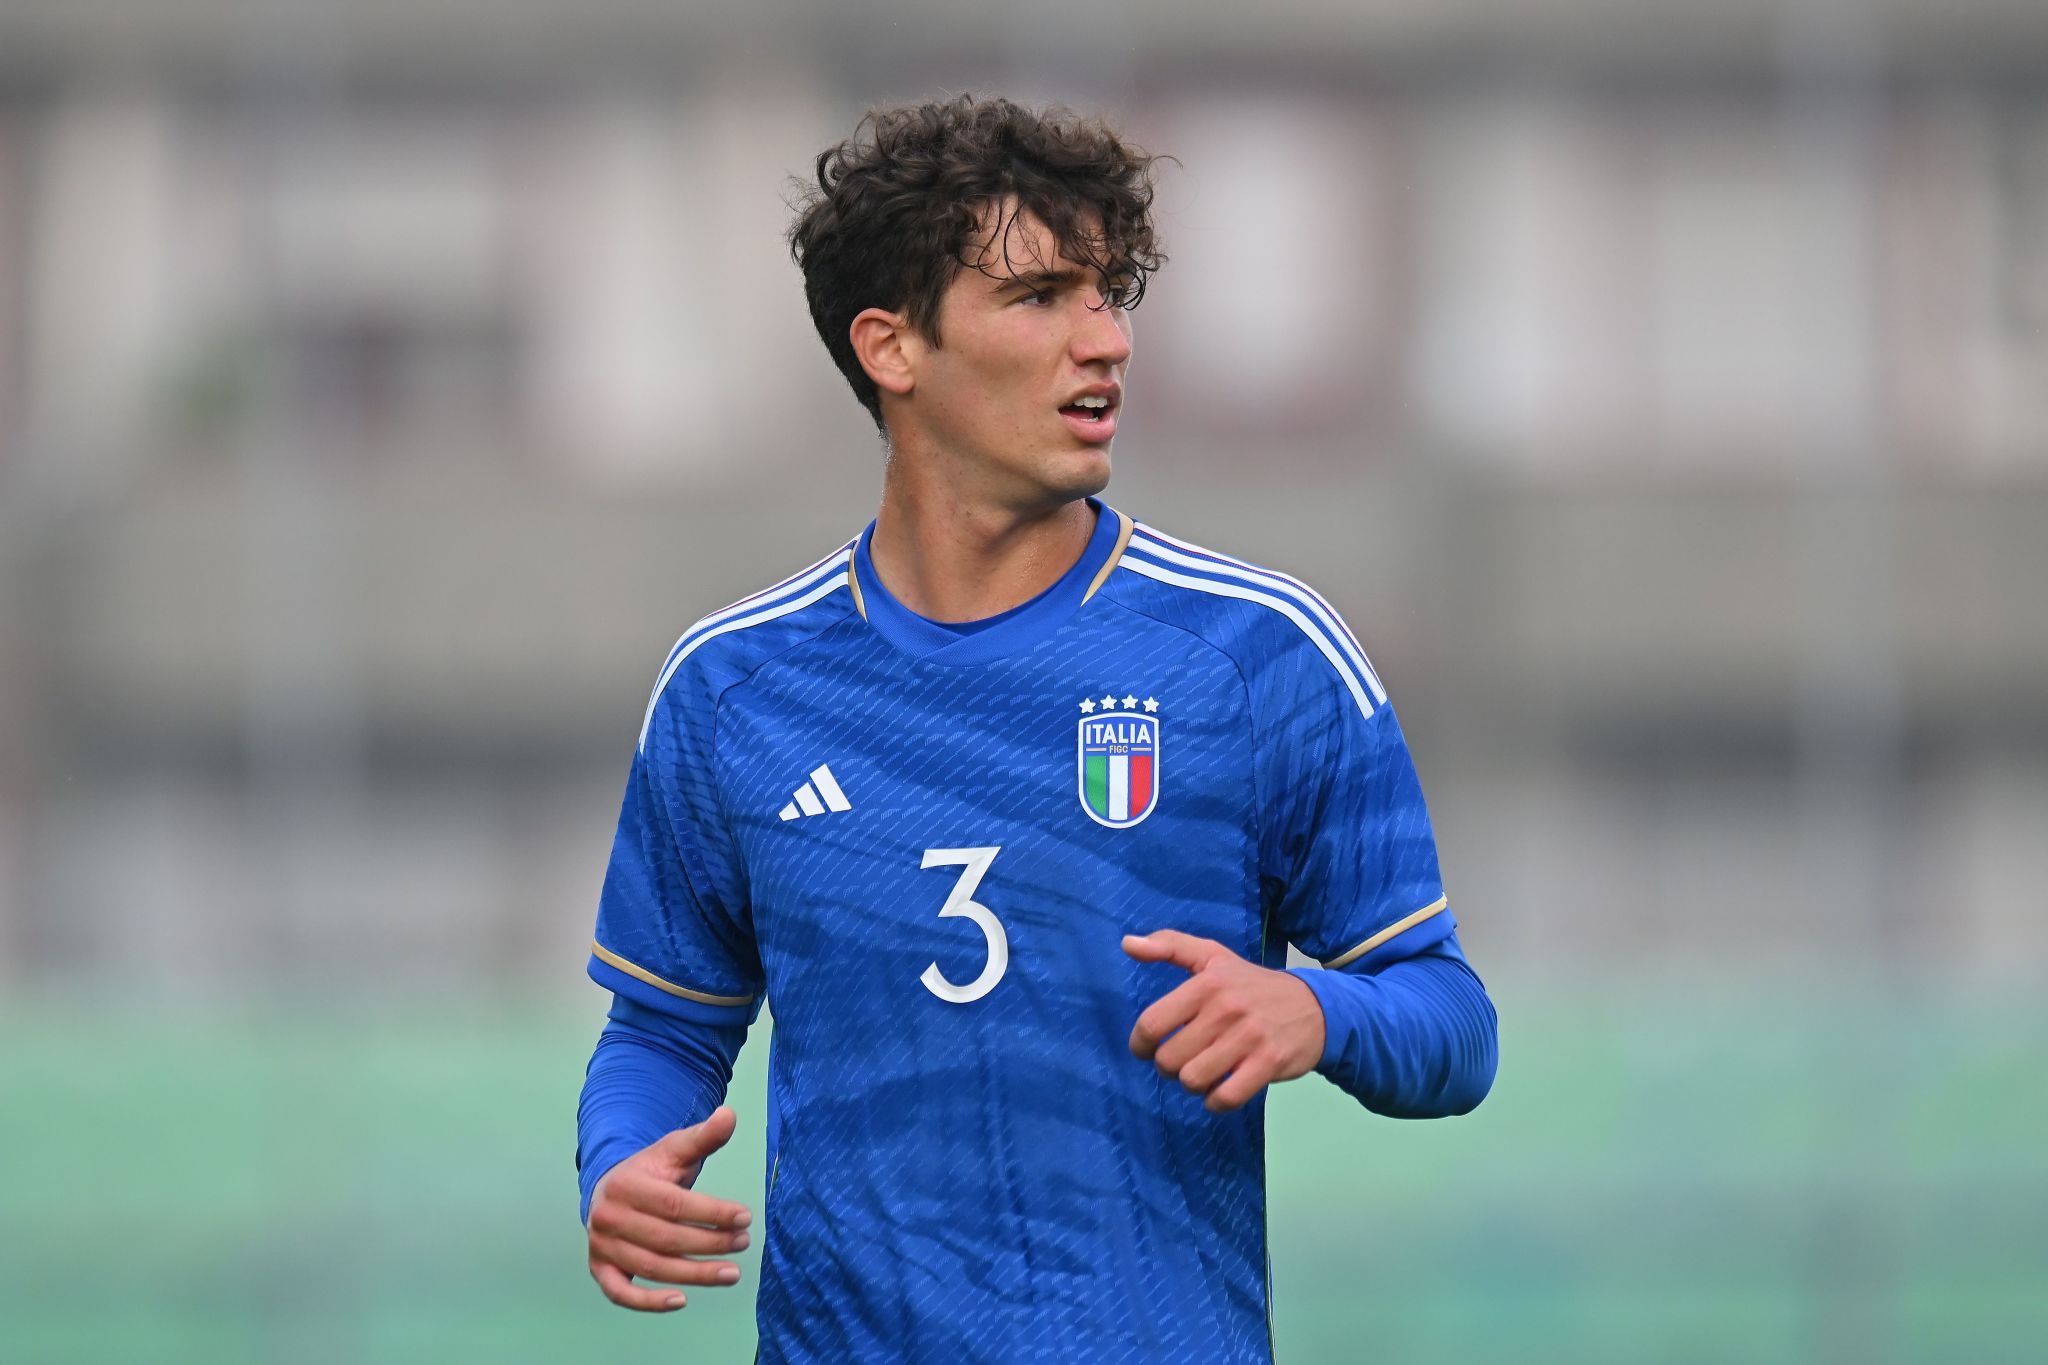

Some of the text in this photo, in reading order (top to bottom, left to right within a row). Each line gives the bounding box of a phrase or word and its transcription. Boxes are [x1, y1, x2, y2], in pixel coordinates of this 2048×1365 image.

[1086, 723, 1152, 744] ITALIA
[1109, 745, 1129, 754] FIGC
[919, 846, 1009, 1004] 3
